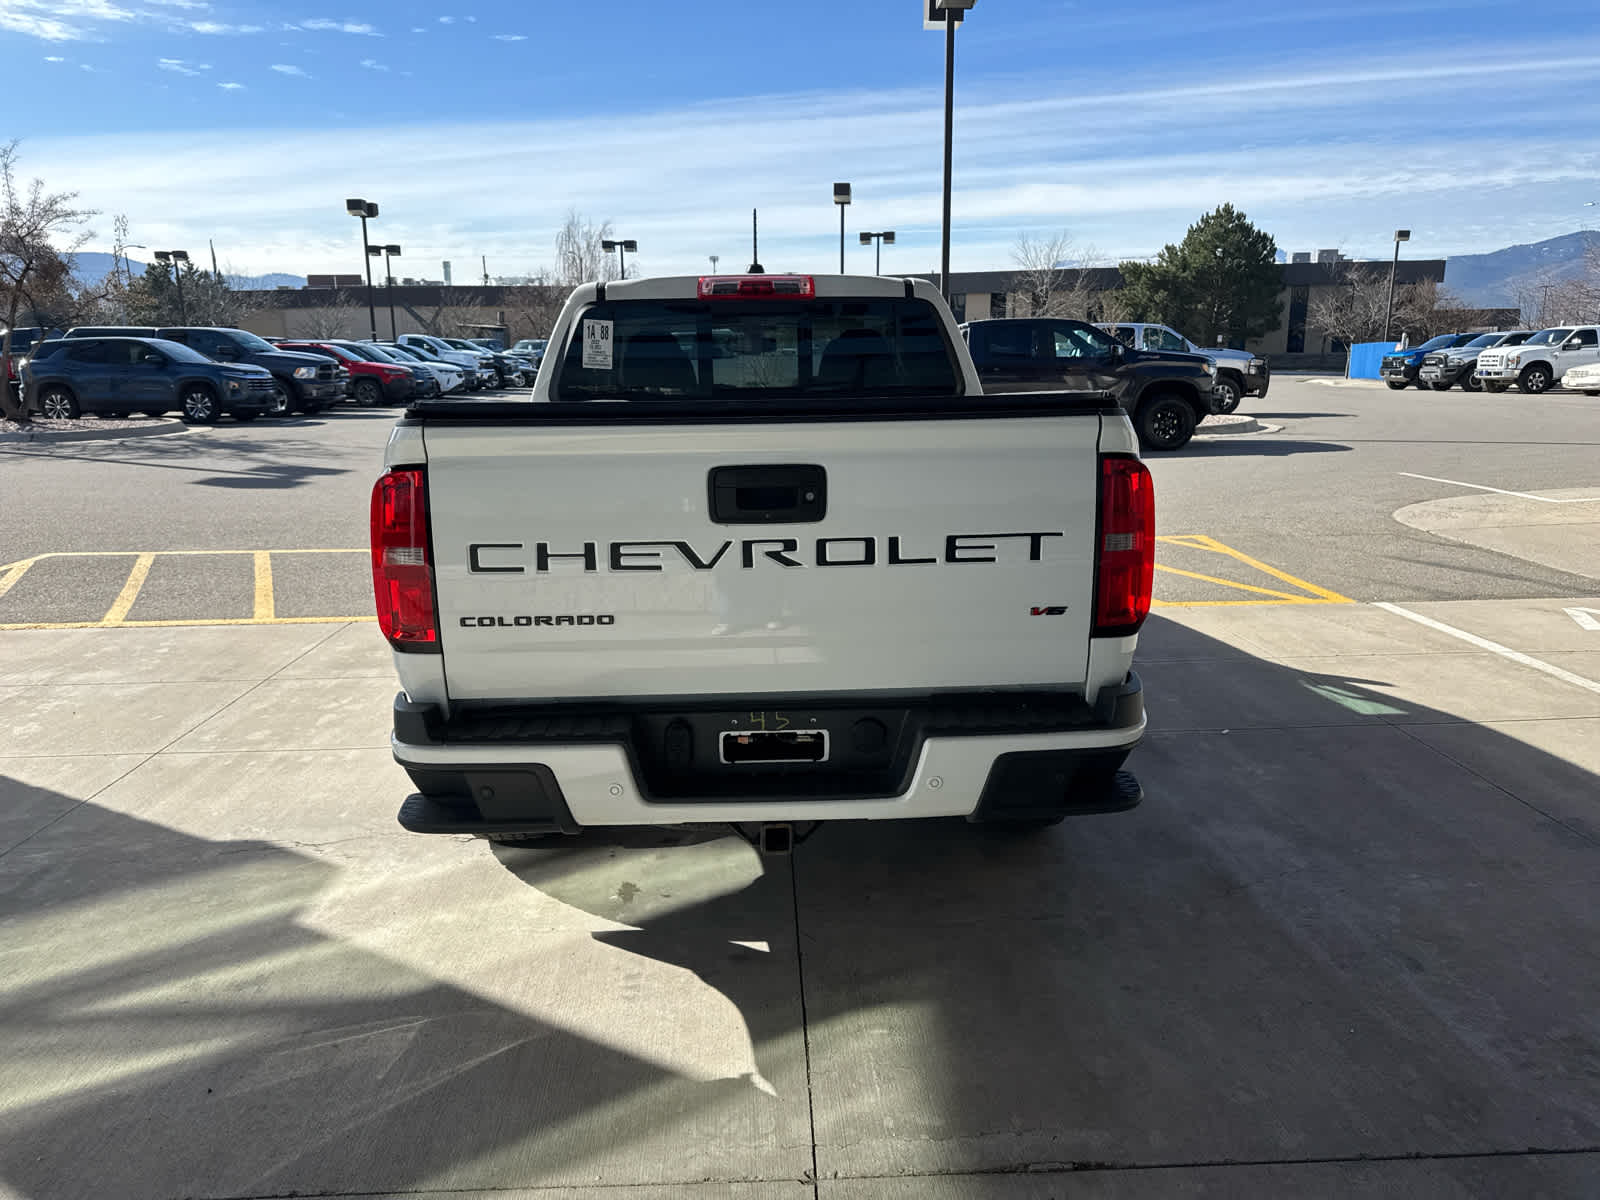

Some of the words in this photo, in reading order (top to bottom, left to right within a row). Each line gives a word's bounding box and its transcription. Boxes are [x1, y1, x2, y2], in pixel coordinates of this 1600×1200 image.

[600, 325, 609, 340] 88
[468, 532, 1064, 574] CHEVROLET
[459, 614, 615, 628] COLORADO
